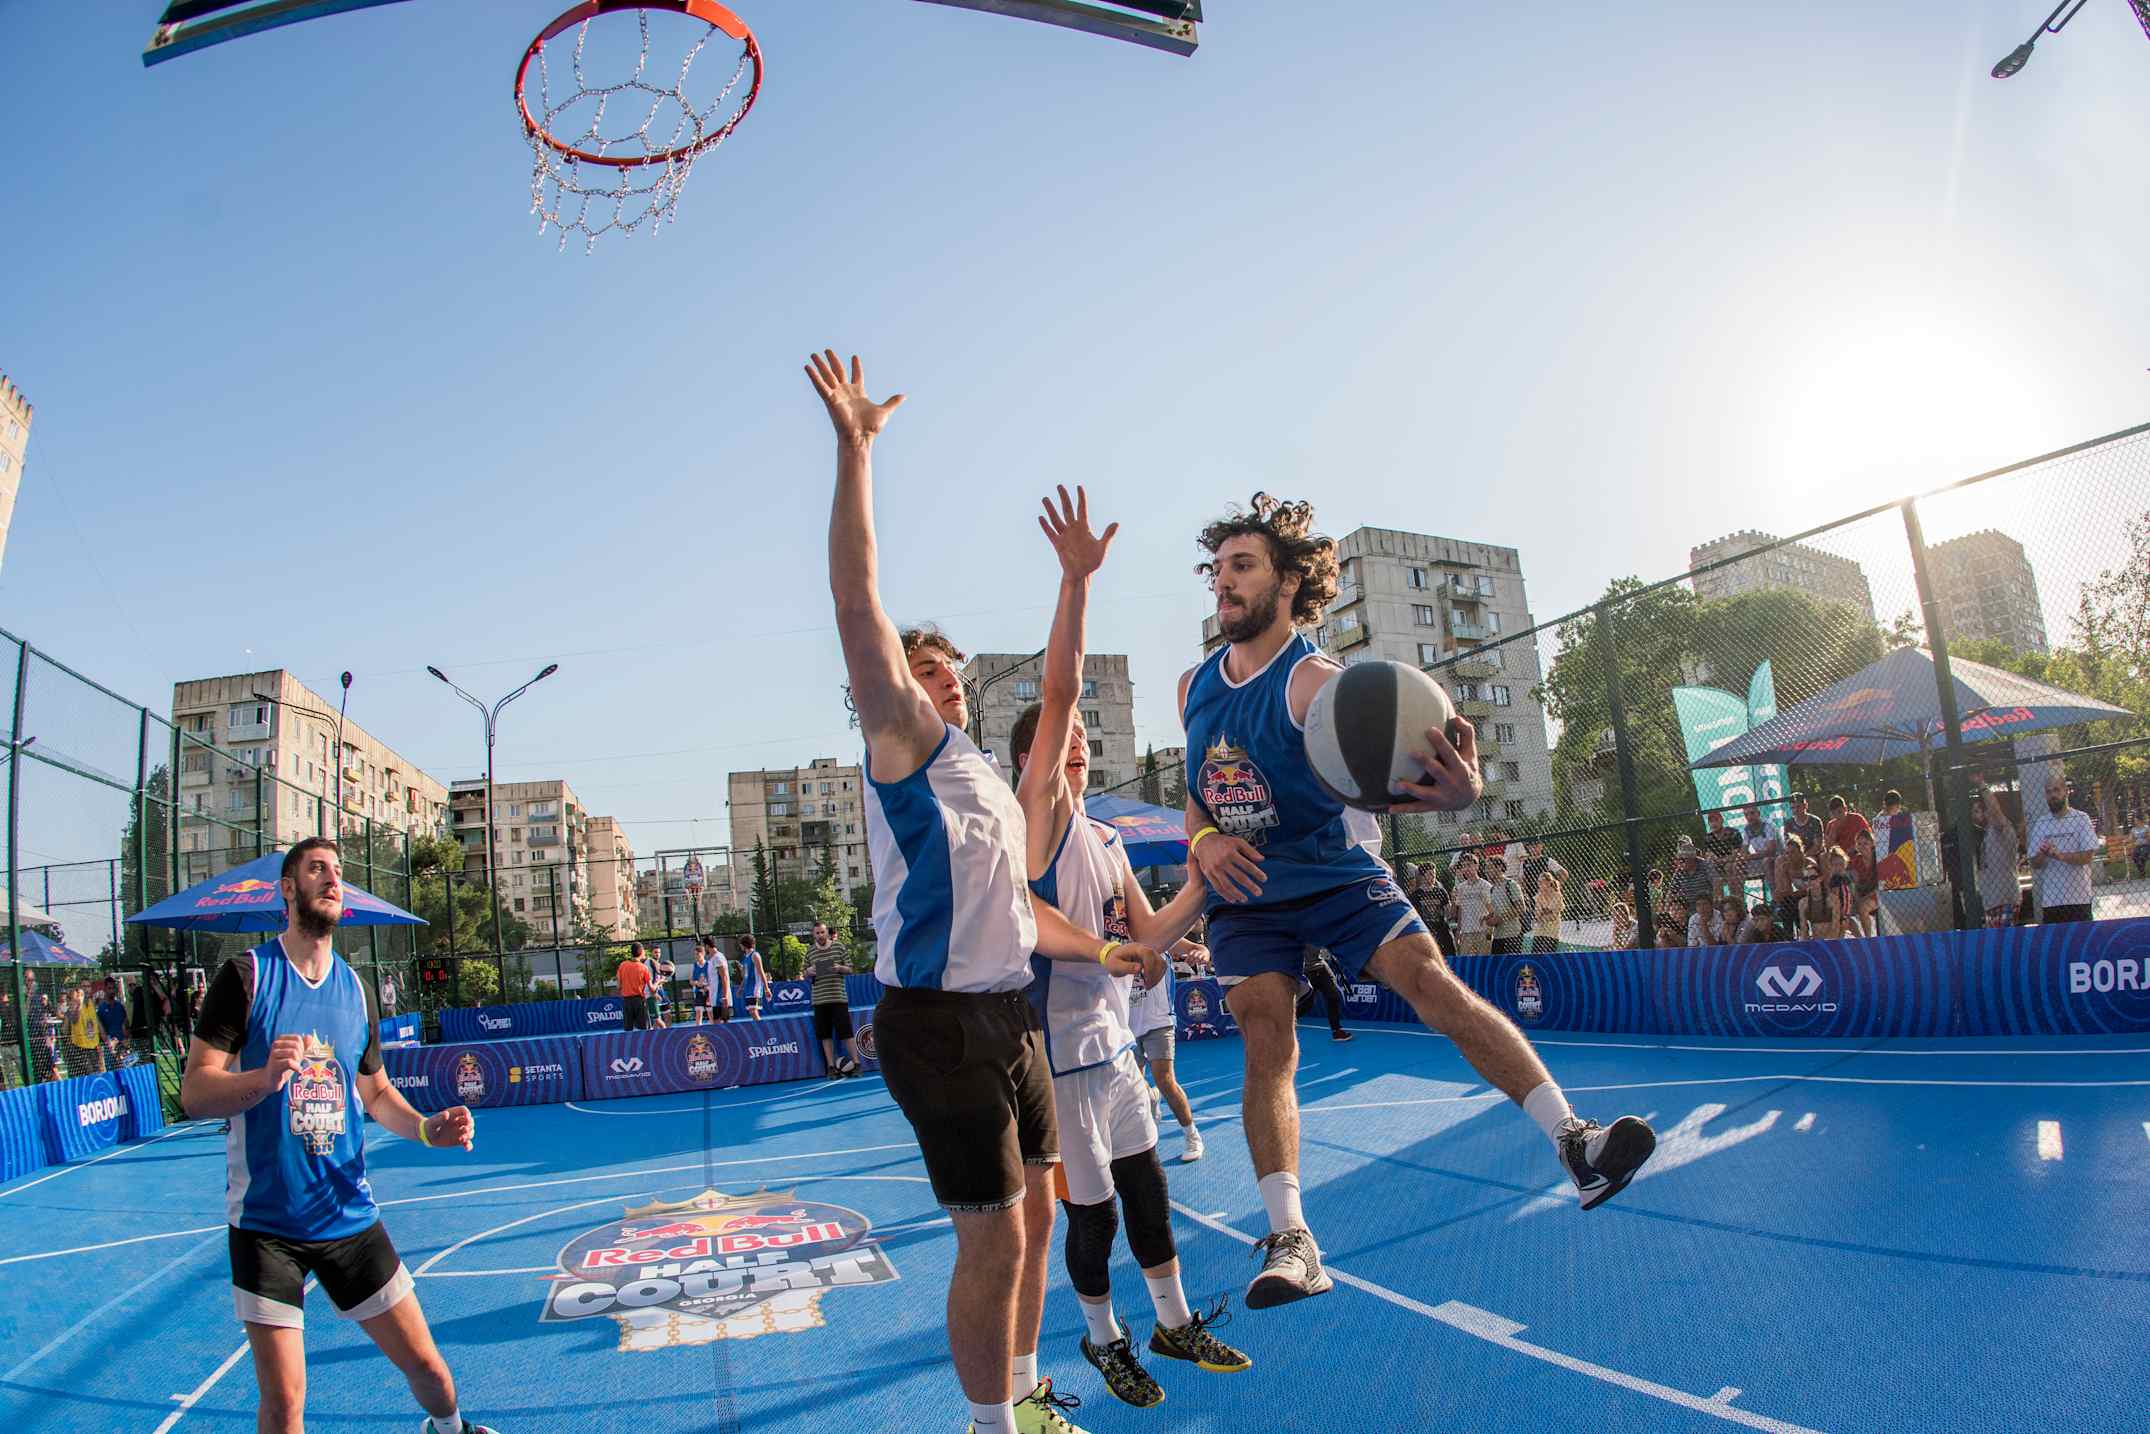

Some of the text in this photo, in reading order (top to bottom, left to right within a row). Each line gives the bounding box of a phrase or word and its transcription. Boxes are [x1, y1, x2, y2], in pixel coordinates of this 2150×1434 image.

[1203, 784, 1266, 805] Red Bull
[1219, 805, 1254, 816] HALF
[1217, 807, 1274, 832] OURT
[195, 891, 275, 907] Red Bull
[587, 1010, 624, 1024] SPALDIN
[748, 1042, 799, 1059] SPALDING
[524, 1064, 562, 1074] SETANTA
[525, 1073, 564, 1082] SPORTS
[391, 1076, 429, 1088] ORJOMI
[293, 1083, 342, 1100] Red Bull
[79, 1095, 128, 1126] BORJOMI
[583, 1221, 847, 1268] Red Bull
[640, 1251, 789, 1279] HALF
[553, 1248, 877, 1317] COURT
[679, 1293, 757, 1307] GEORGIA
